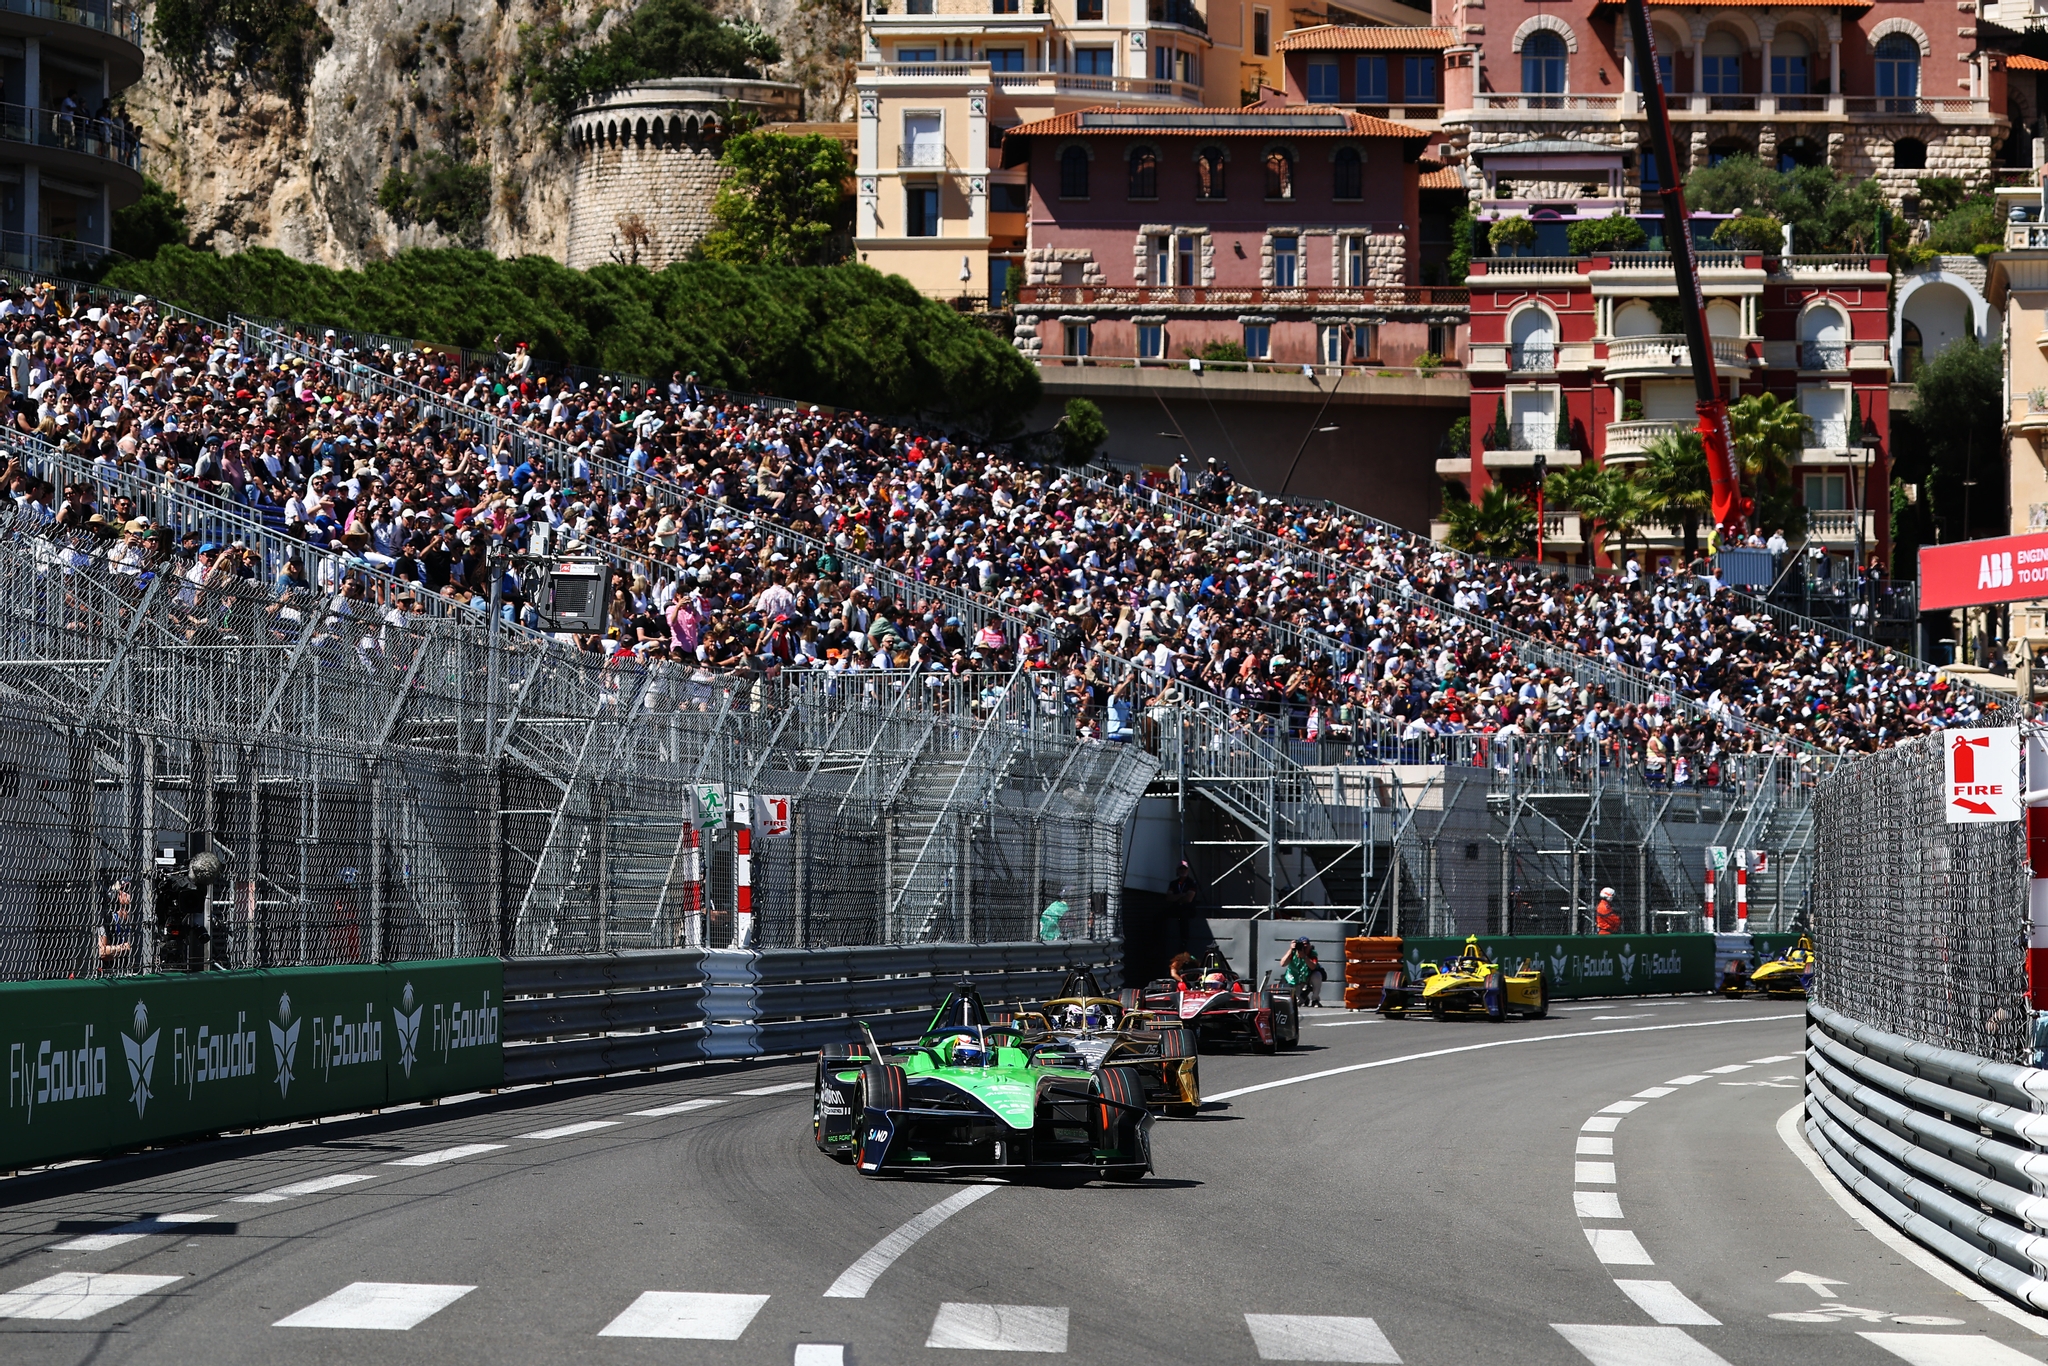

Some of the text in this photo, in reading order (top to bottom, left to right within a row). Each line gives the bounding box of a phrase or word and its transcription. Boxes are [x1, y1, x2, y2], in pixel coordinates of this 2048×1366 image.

[1643, 6, 1662, 85] IMPERIAL LEVAGE
[1683, 219, 1705, 309] IMPERIAL LEVAGE
[1721, 414, 1738, 480] IMPERIAL
[1977, 551, 2013, 590] ABB
[2017, 569, 2031, 583] TO
[1954, 784, 2003, 796] FIRE
